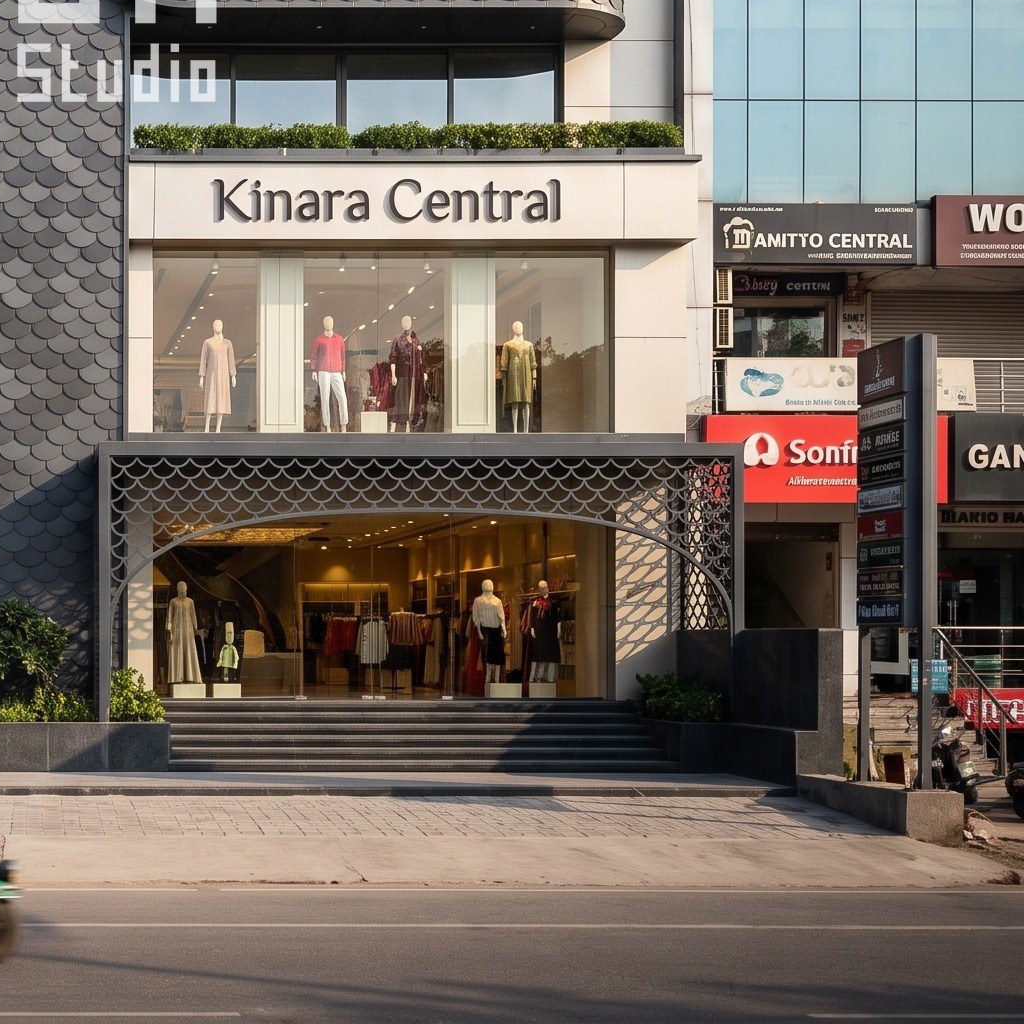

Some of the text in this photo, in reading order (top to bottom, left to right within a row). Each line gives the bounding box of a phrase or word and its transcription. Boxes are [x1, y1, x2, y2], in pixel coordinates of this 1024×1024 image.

[211, 178, 562, 223] Kinara Central
[754, 233, 823, 248] AMITTO
[829, 233, 913, 248] CENTRAL
